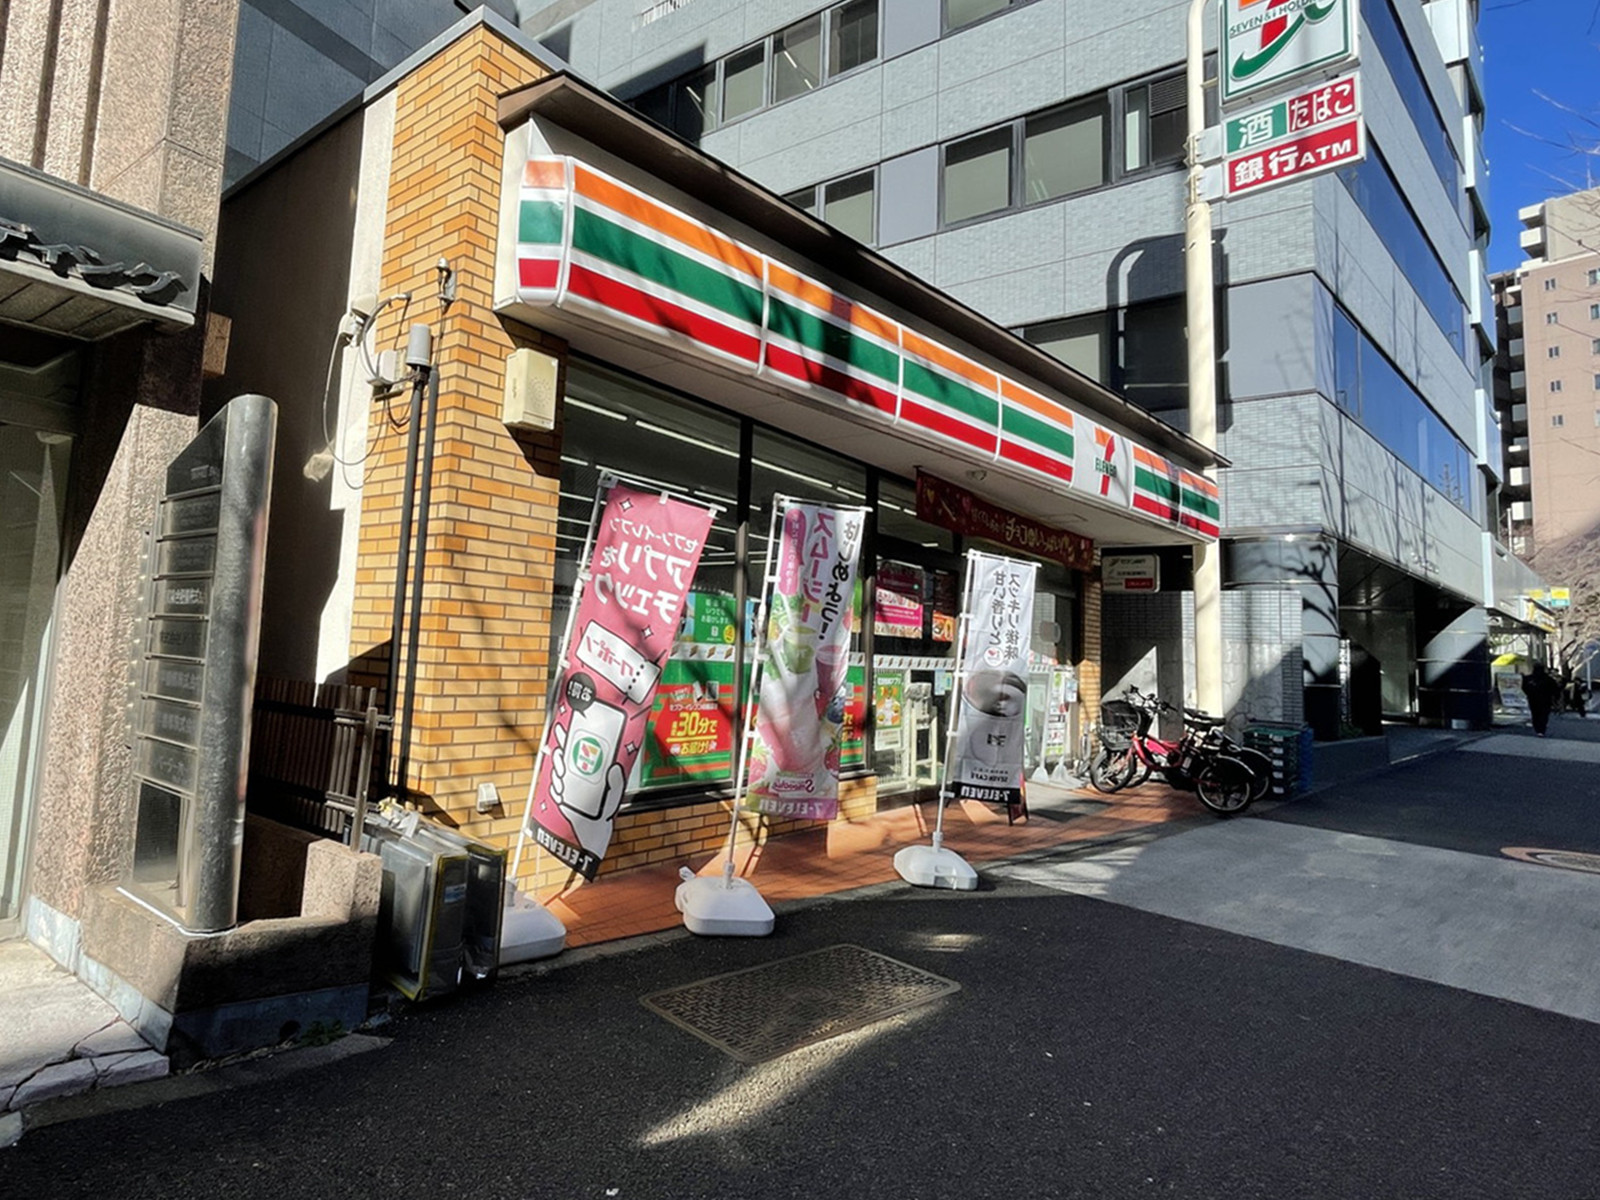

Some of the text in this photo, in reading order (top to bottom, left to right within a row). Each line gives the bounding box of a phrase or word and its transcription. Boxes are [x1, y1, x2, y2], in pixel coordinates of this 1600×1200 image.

[1229, 14, 1263, 35] SEVEN
[1291, 84, 1353, 131] たばこ
[1239, 109, 1273, 148] 酒
